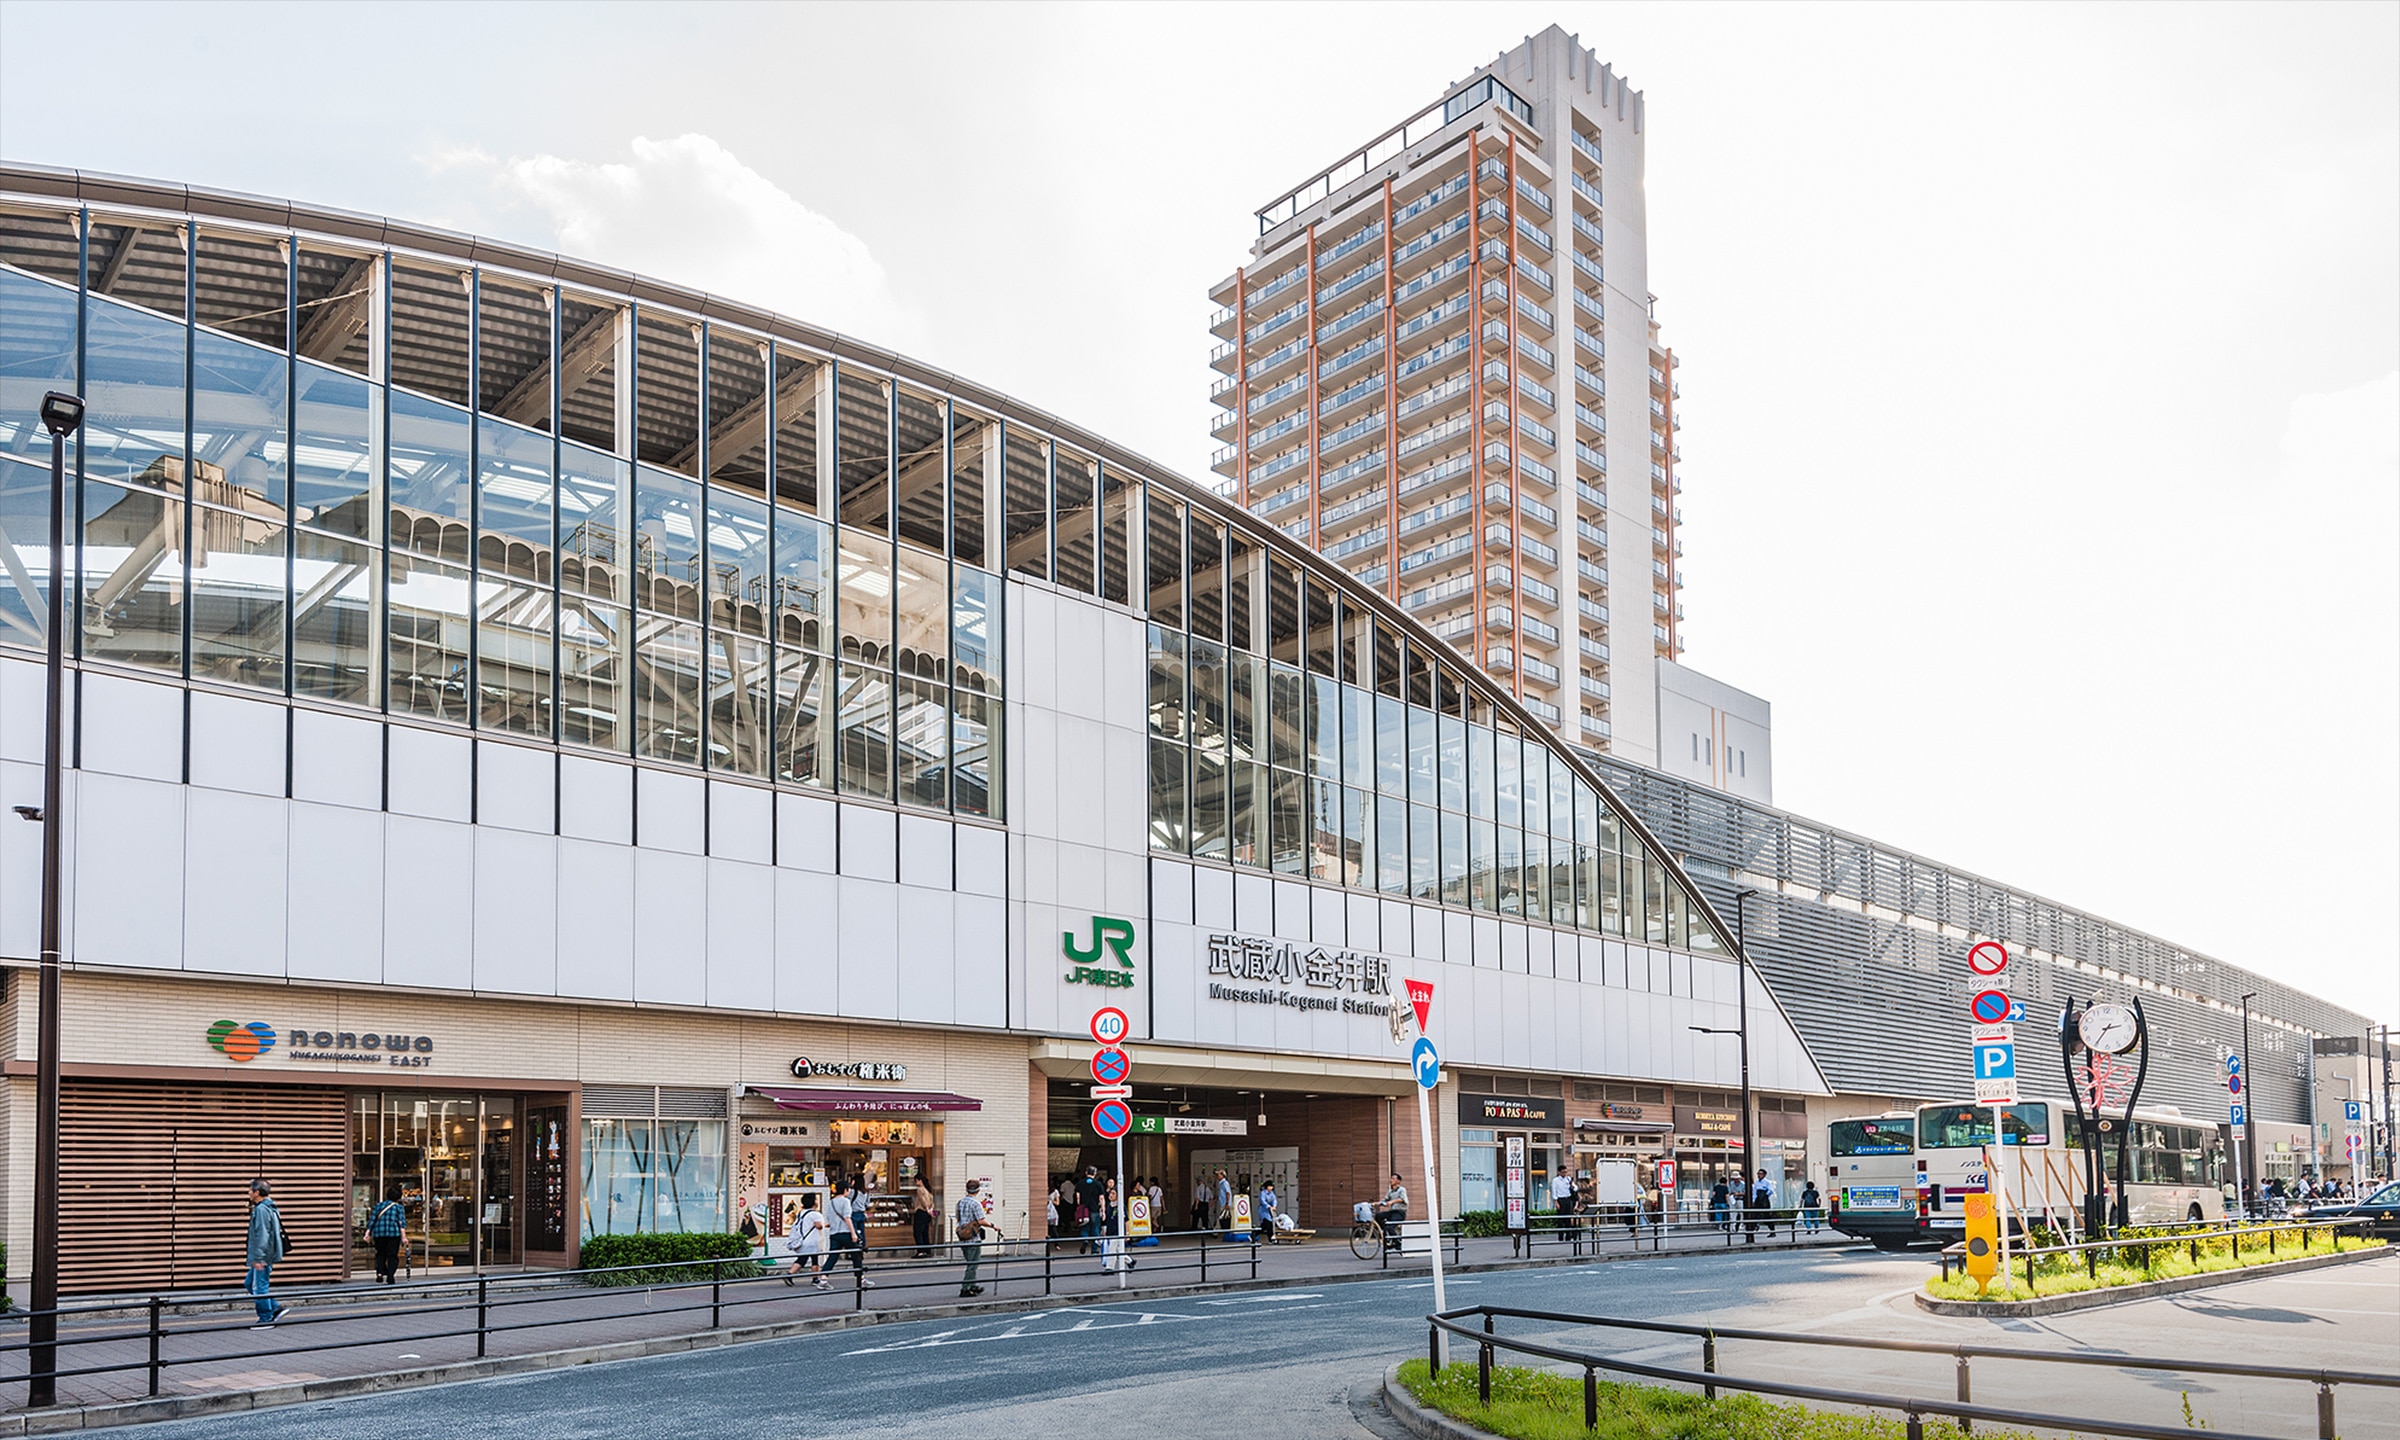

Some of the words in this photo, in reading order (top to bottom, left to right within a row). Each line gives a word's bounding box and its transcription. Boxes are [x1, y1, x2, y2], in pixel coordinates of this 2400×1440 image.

[1062, 916, 1135, 968] JR
[1209, 934, 1391, 996] 武蔵小金井駅
[1065, 966, 1135, 989] JR東日本
[1209, 982, 1338, 1012] Musashi-Koganei
[1342, 996, 1389, 1017] Station
[1411, 988, 1430, 1003] 止まれ
[1099, 1018, 1120, 1034] 40
[290, 1030, 433, 1053] nonowa
[389, 1056, 432, 1067] EAST
[1983, 1047, 2007, 1077] P
[1485, 1106, 1505, 1118] POTA
[1506, 1107, 1529, 1119] PASTA
[2233, 1107, 2241, 1123] P
[2348, 1103, 2358, 1118] P
[1141, 1118, 1155, 1128] JR
